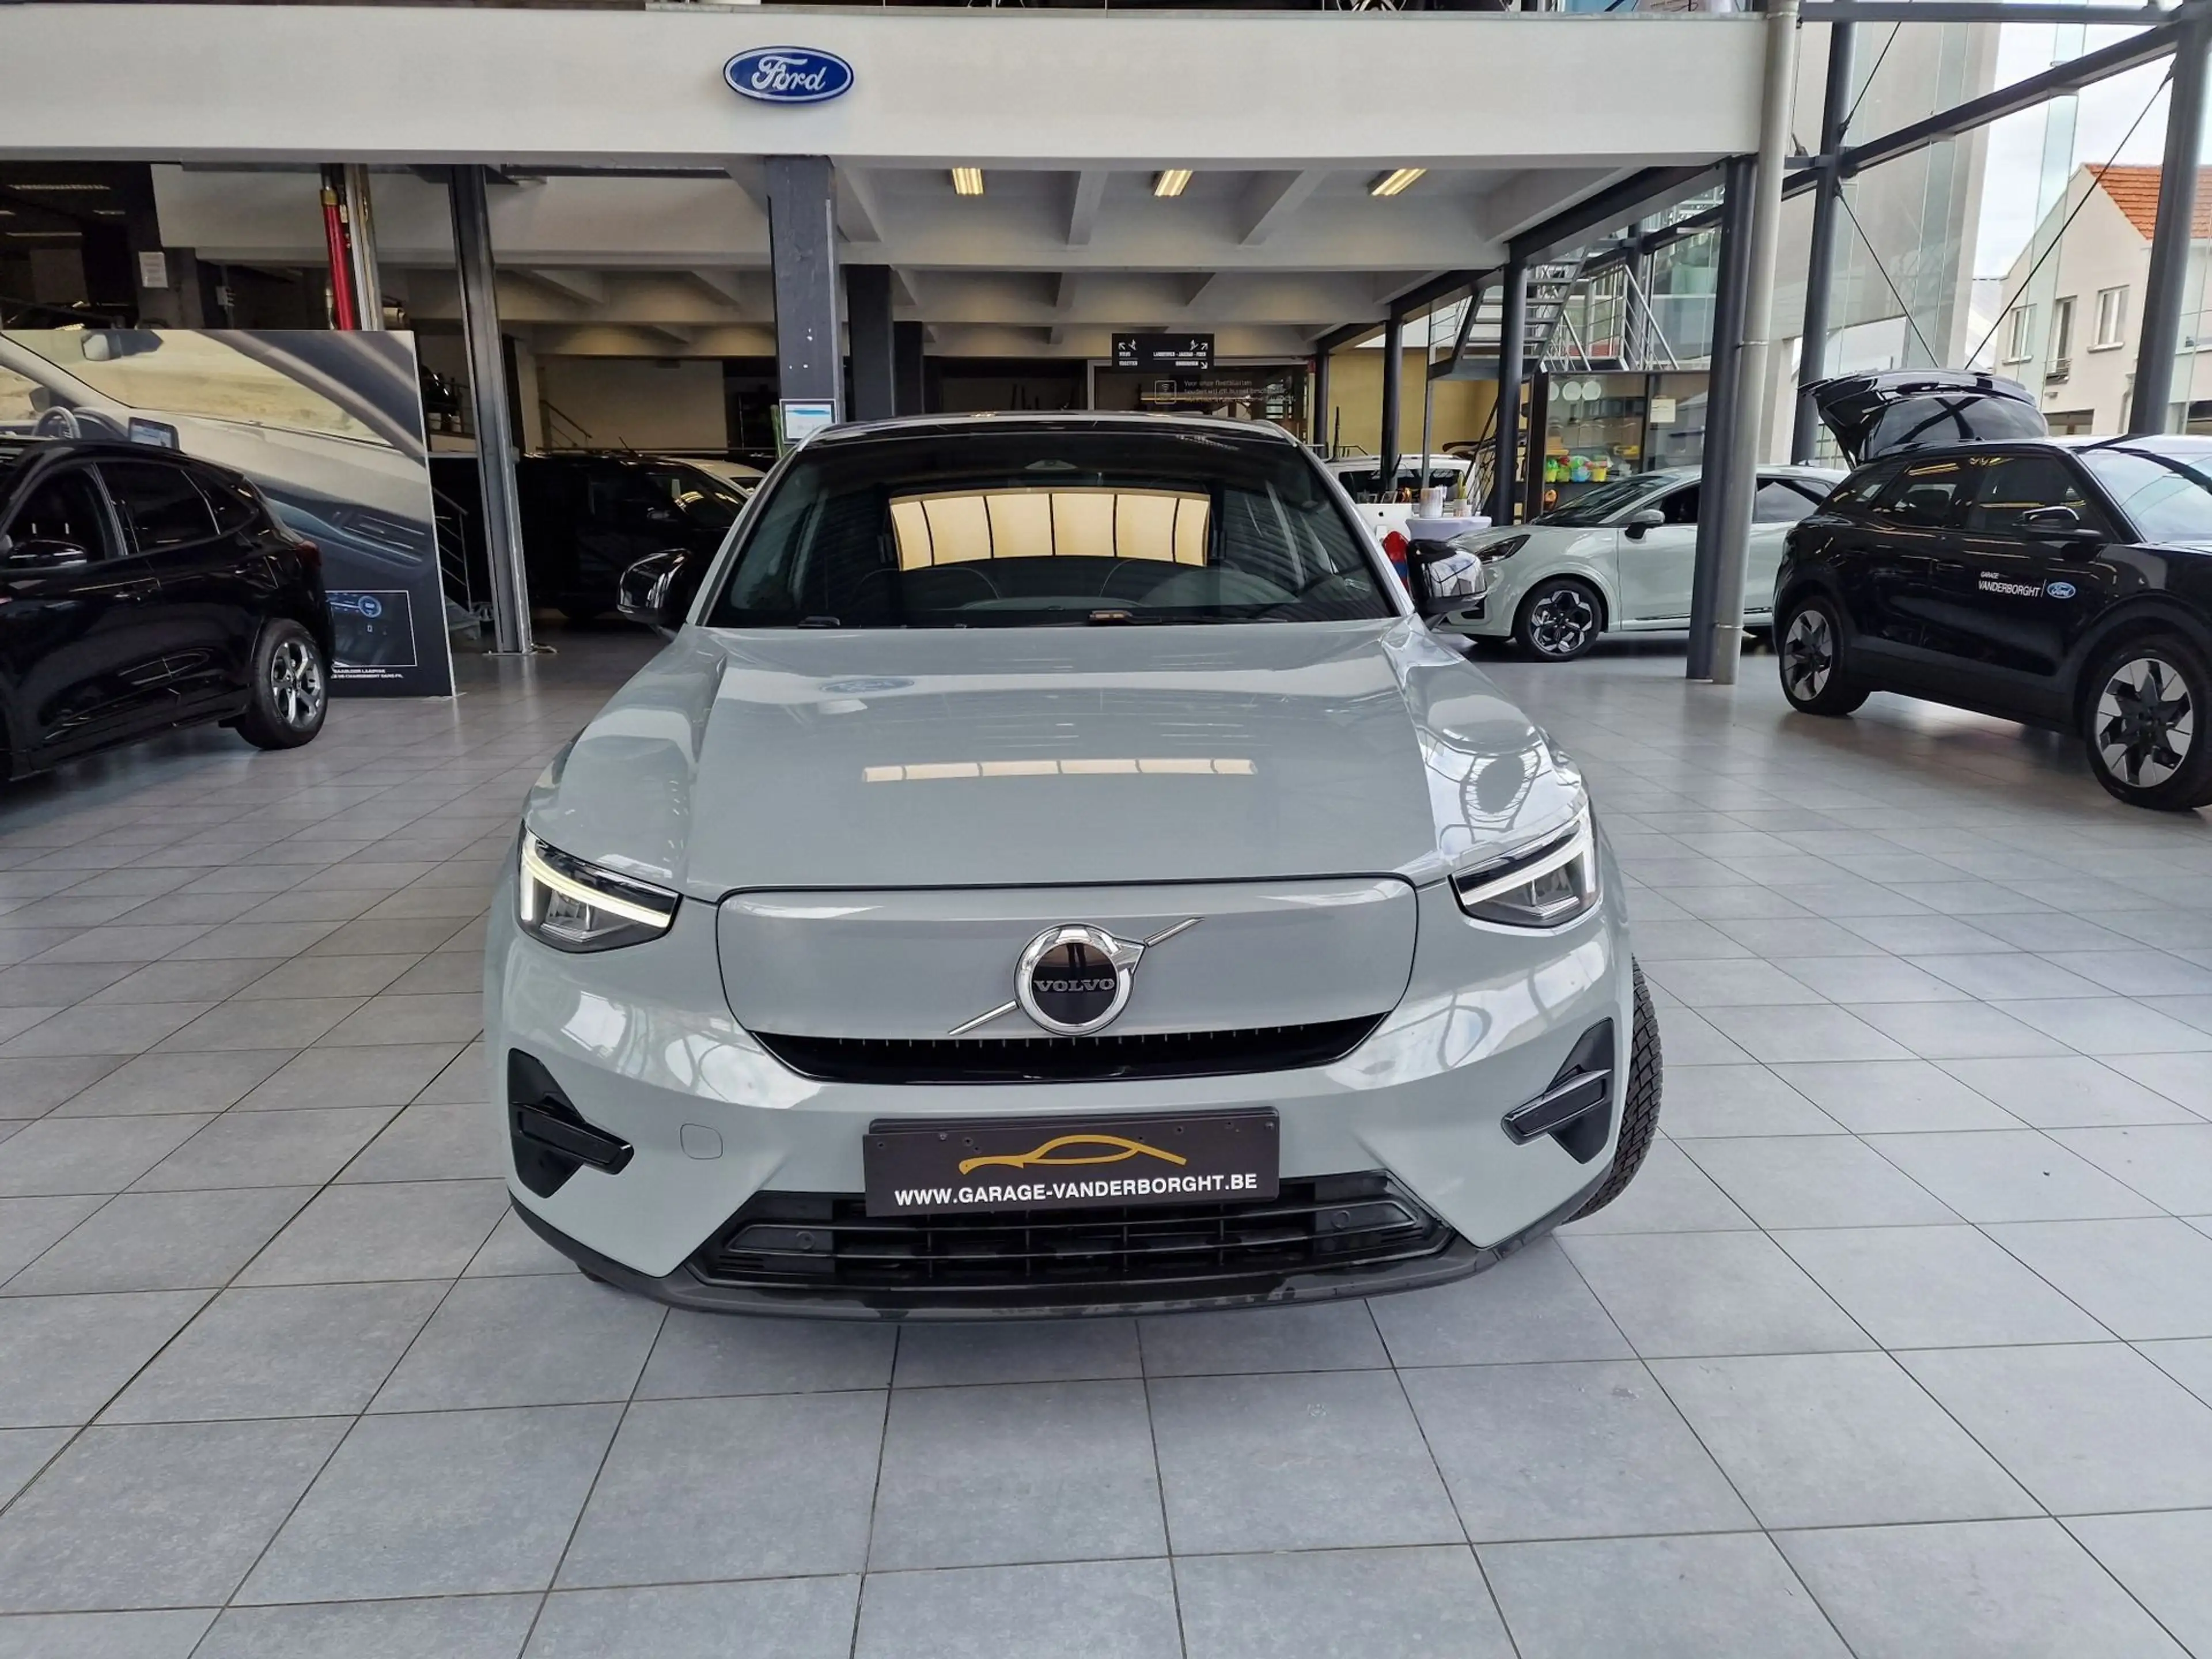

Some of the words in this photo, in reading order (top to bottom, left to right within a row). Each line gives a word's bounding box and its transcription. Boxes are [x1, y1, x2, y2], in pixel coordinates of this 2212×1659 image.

[751, 56, 827, 90] Ford
[1980, 571, 1999, 579] GARAGE
[1978, 580, 2040, 597] VANDERBORGHT
[1033, 978, 1115, 991] VOLVO
[895, 1173, 1257, 1206] WWW.GARAGE-VANDERBORGHT.BE
